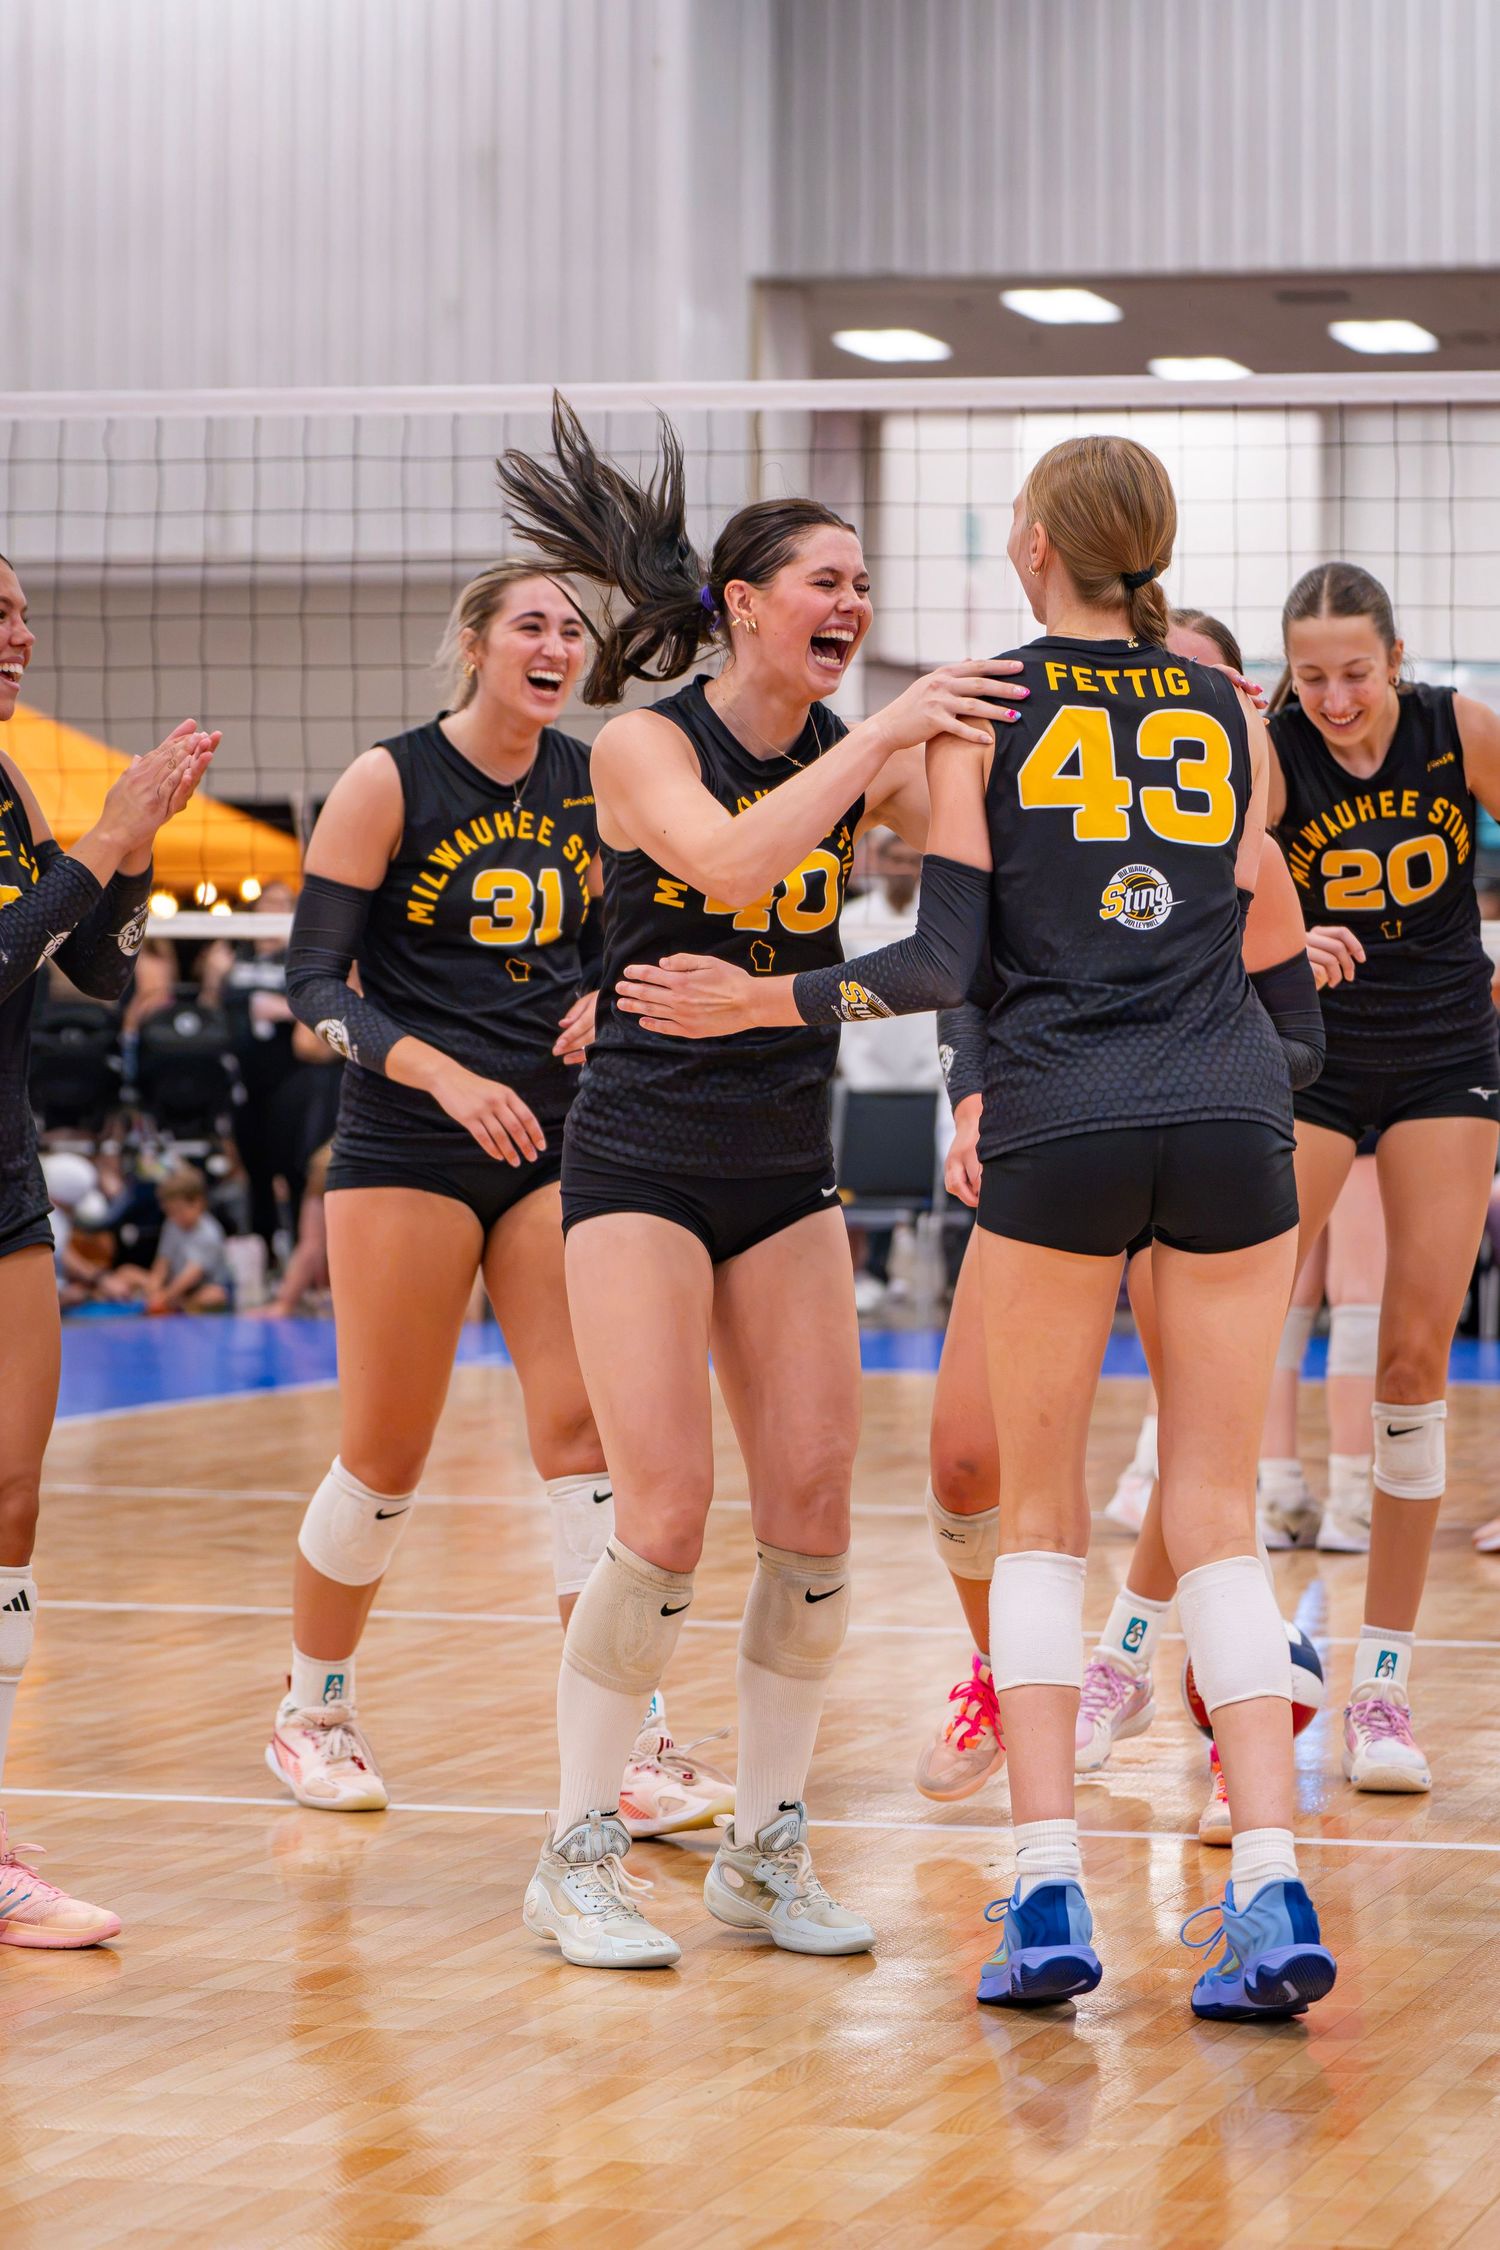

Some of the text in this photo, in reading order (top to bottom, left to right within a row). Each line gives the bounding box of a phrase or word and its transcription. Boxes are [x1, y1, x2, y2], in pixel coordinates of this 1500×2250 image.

[1044, 661, 1191, 698] FETTIG
[1017, 704, 1237, 847] 43
[406, 810, 556, 926] MILWAUKEE
[1287, 790, 1470, 889] MILWAUKEE STING
[1320, 833, 1449, 911] 20
[469, 867, 564, 946] 31
[1099, 882, 1173, 920] Sting
